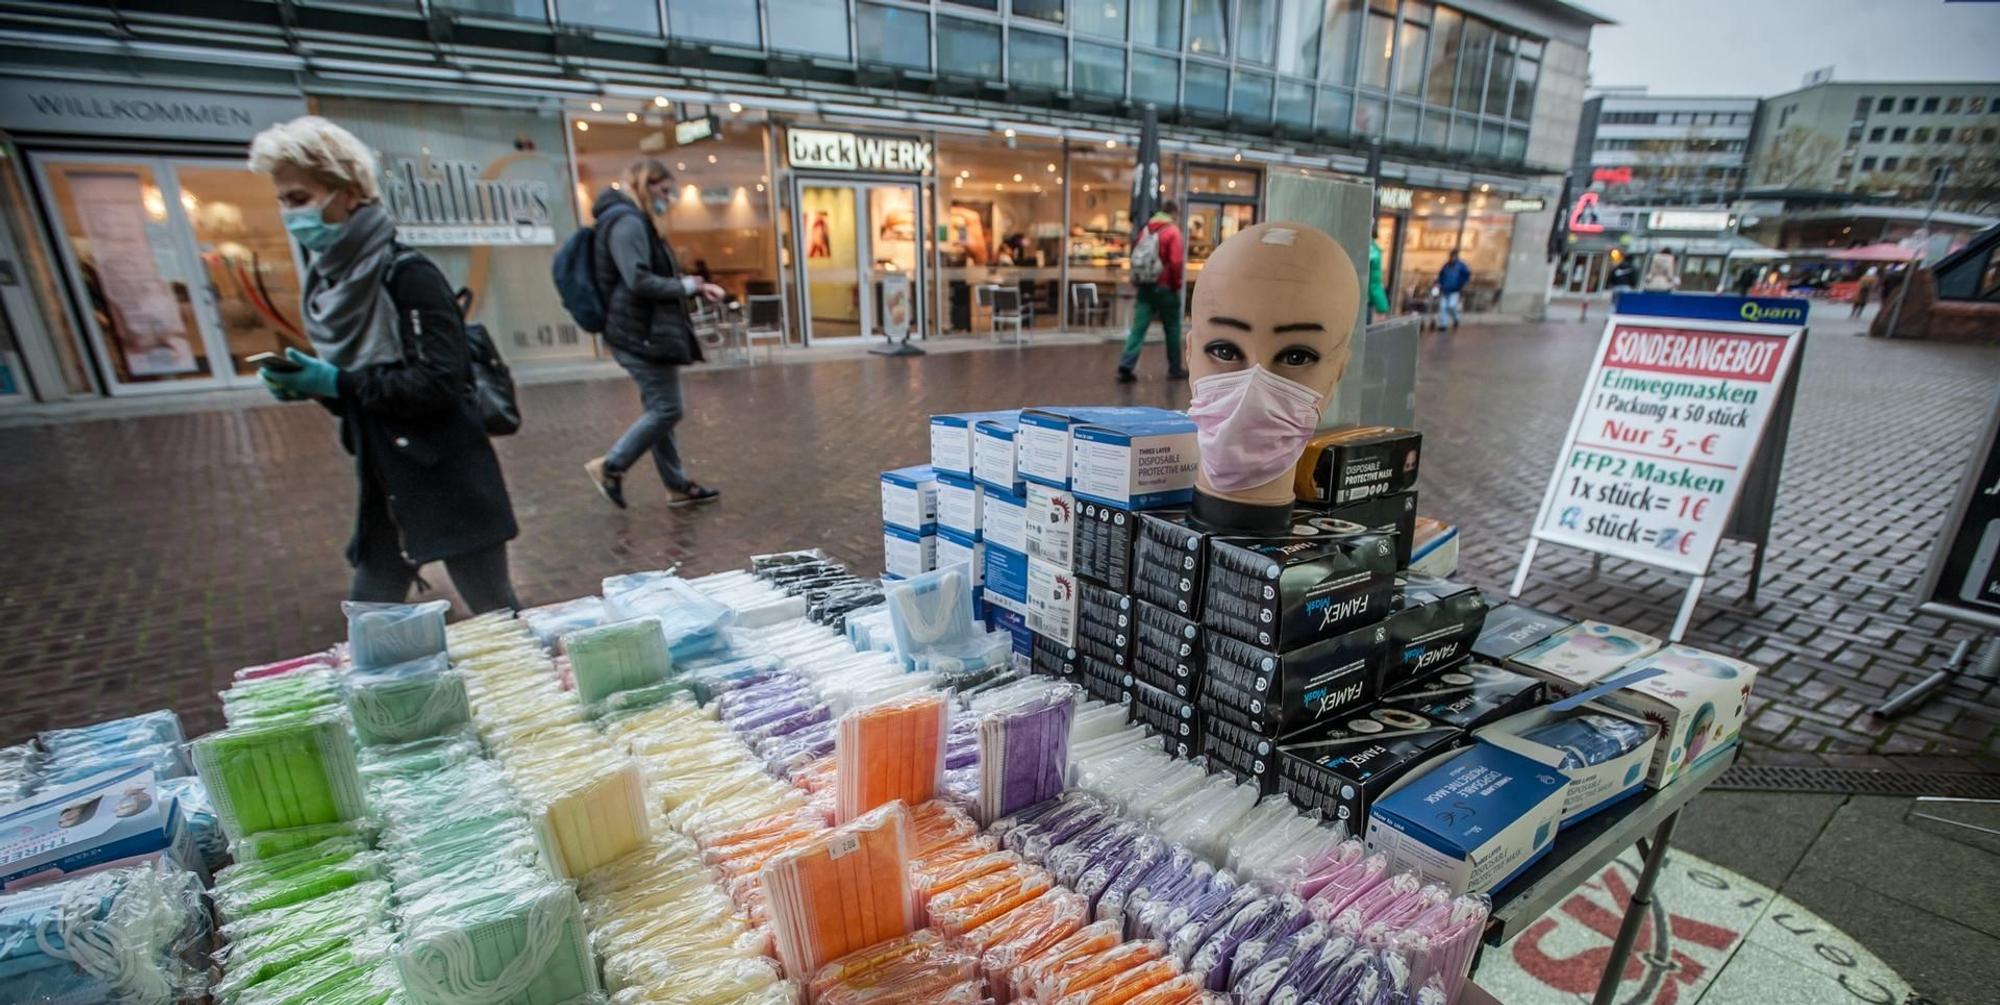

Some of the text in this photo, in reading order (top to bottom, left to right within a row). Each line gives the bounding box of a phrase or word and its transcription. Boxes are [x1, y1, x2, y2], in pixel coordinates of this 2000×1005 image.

[28, 93, 252, 126] WILLKOMMEN
[386, 160, 549, 242] chillings
[1740, 302, 1801, 322] Quam
[1610, 330, 1779, 376] SONDERANGEBOT
[1602, 370, 1759, 404] Einwegmasken
[1595, 394, 1749, 428] 1 Packung x 50 stück
[1601, 420, 1653, 445] Nur
[1138, 455, 1180, 466] DISPOSABLE
[1138, 465, 1179, 477] PROTECTIVE
[1346, 461, 1380, 475] DISPOSABLE
[1571, 451, 1725, 494] FFP2 Masken
[1344, 469, 1393, 486] PROTECTIVE MASK
[1570, 475, 1710, 522] 1x stück= 1€
[1306, 594, 1369, 631] FAMEX Mask
[1412, 642, 1459, 674] FAMEX
[1304, 681, 1363, 719] FAMEX Mask
[1346, 744, 1387, 768] FAMEX
[1444, 765, 1488, 791] PROTECTIVE
[1456, 770, 1502, 798] DISPOSABLE
[1424, 788, 1450, 804] MASK
[1660, 855, 1896, 1005] Cente
